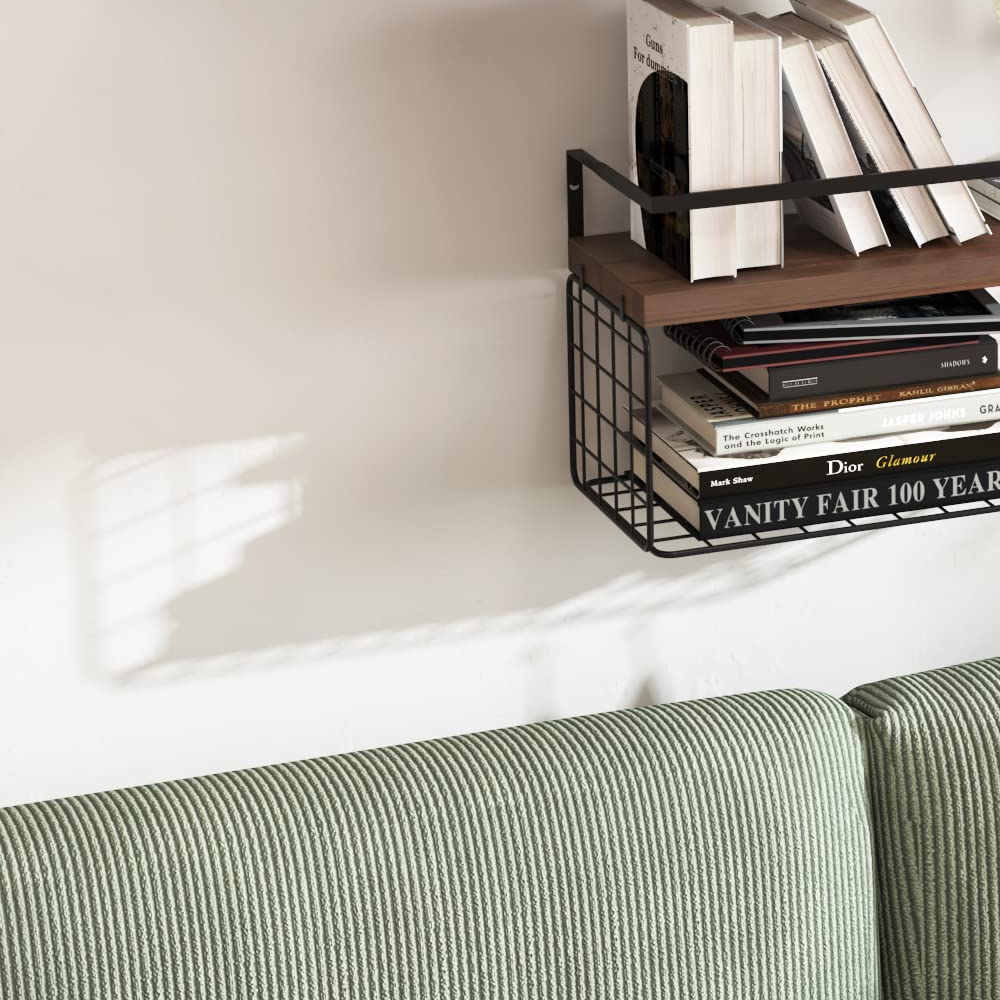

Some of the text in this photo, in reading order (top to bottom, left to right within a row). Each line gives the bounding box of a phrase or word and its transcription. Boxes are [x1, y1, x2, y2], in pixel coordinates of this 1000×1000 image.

[645, 33, 664, 55] Guns
[633, 46, 646, 64] For
[940, 358, 971, 369] SHADOWS
[791, 380, 976, 411] THE PROPHET KAHLIL GIBRAN
[882, 412, 925, 428] JASPER
[928, 407, 967, 421] JOHNS
[723, 424, 824, 443] The Crosshatch Works
[724, 441, 742, 450] and
[746, 438, 762, 447] the
[765, 435, 789, 446] Logic
[804, 431, 825, 440] Print
[826, 452, 937, 476] Dior Glamour
[710, 475, 754, 488] Mark Shaw
[704, 496, 809, 531] VANITY
[816, 487, 880, 517] FAIR
[888, 480, 926, 507] 100
